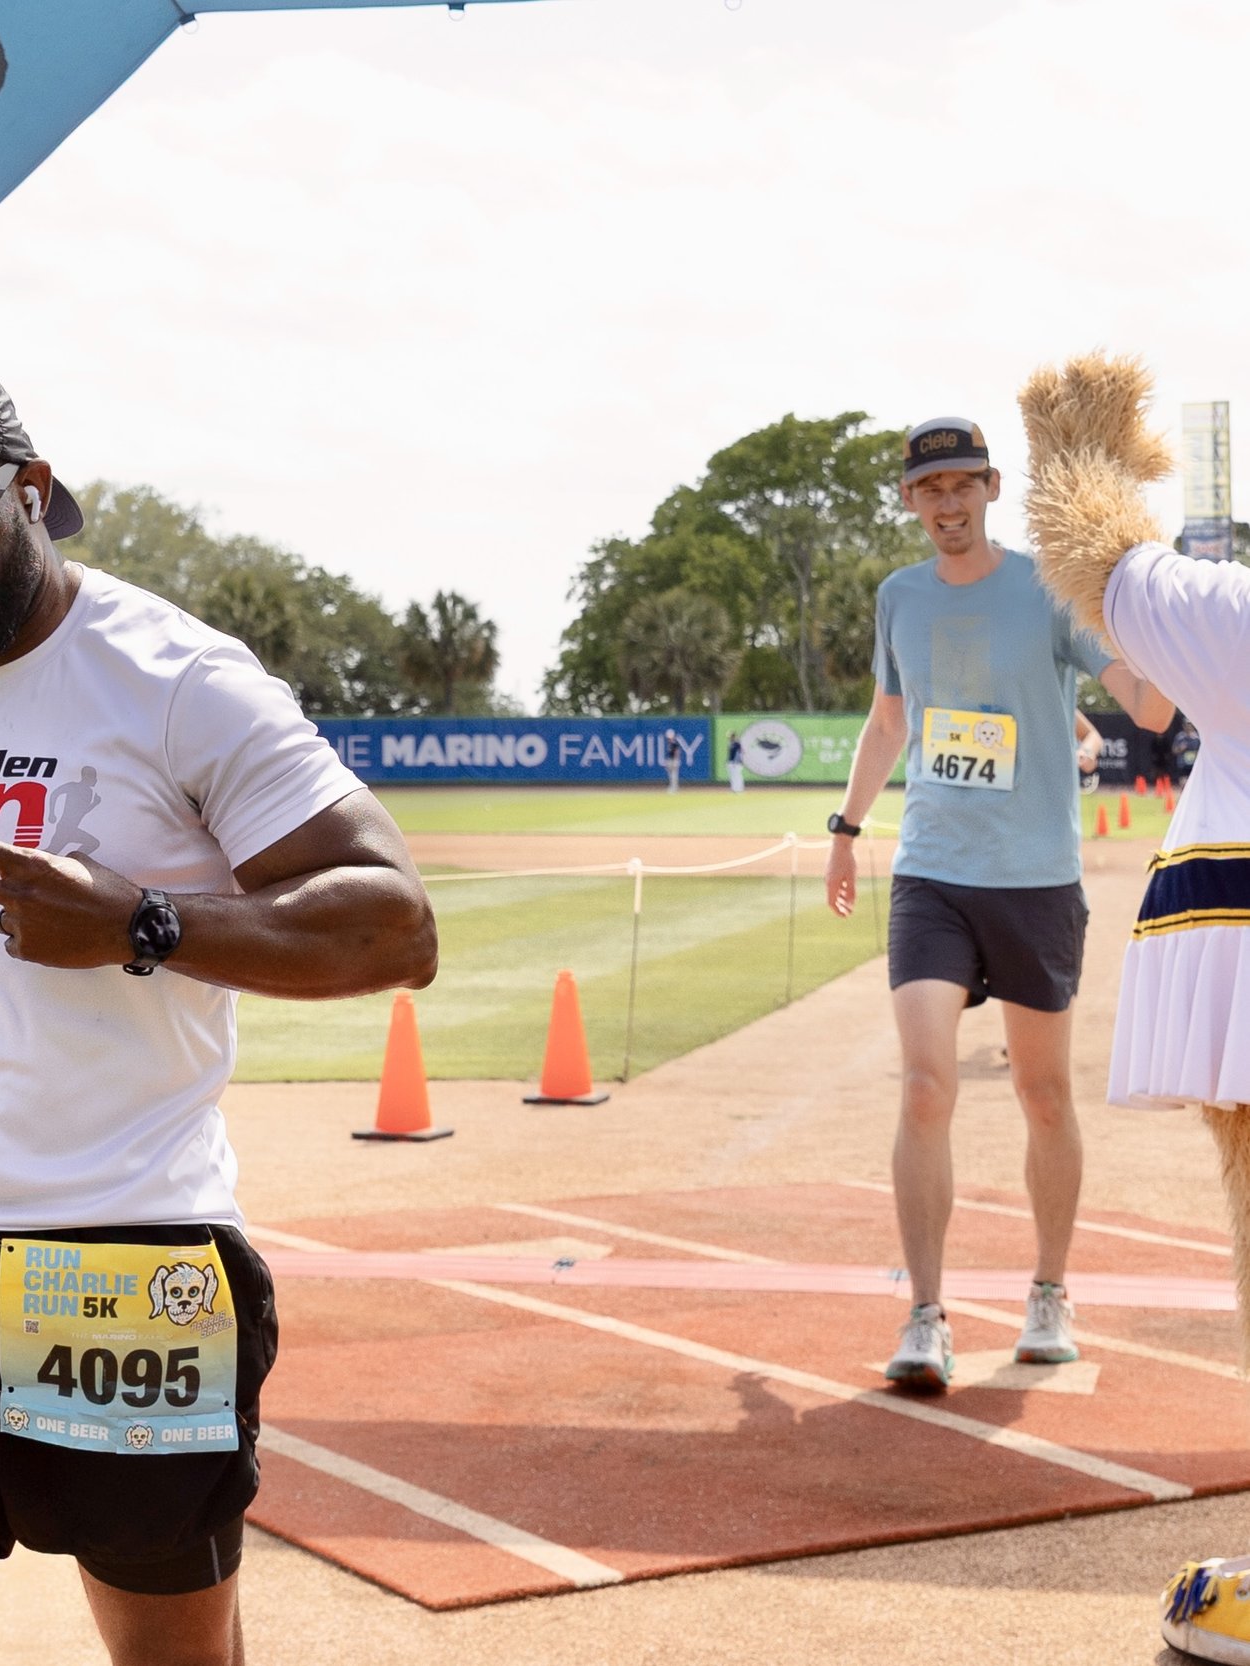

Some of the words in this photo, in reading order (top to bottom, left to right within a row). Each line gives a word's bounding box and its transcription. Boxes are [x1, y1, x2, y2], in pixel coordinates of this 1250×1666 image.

[381, 734, 548, 767] MARINO
[559, 734, 704, 767] FAMILY
[932, 753, 997, 784] 4674
[25, 1247, 81, 1270] RUN
[23, 1270, 138, 1296] CHARLIE
[23, 1293, 79, 1317] RUN
[83, 1297, 118, 1319] 5K
[37, 1344, 200, 1408] 4095
[36, 1416, 66, 1434] ONE
[69, 1423, 110, 1442] BEER
[161, 1427, 193, 1443] ONE
[197, 1424, 235, 1442] BEER
